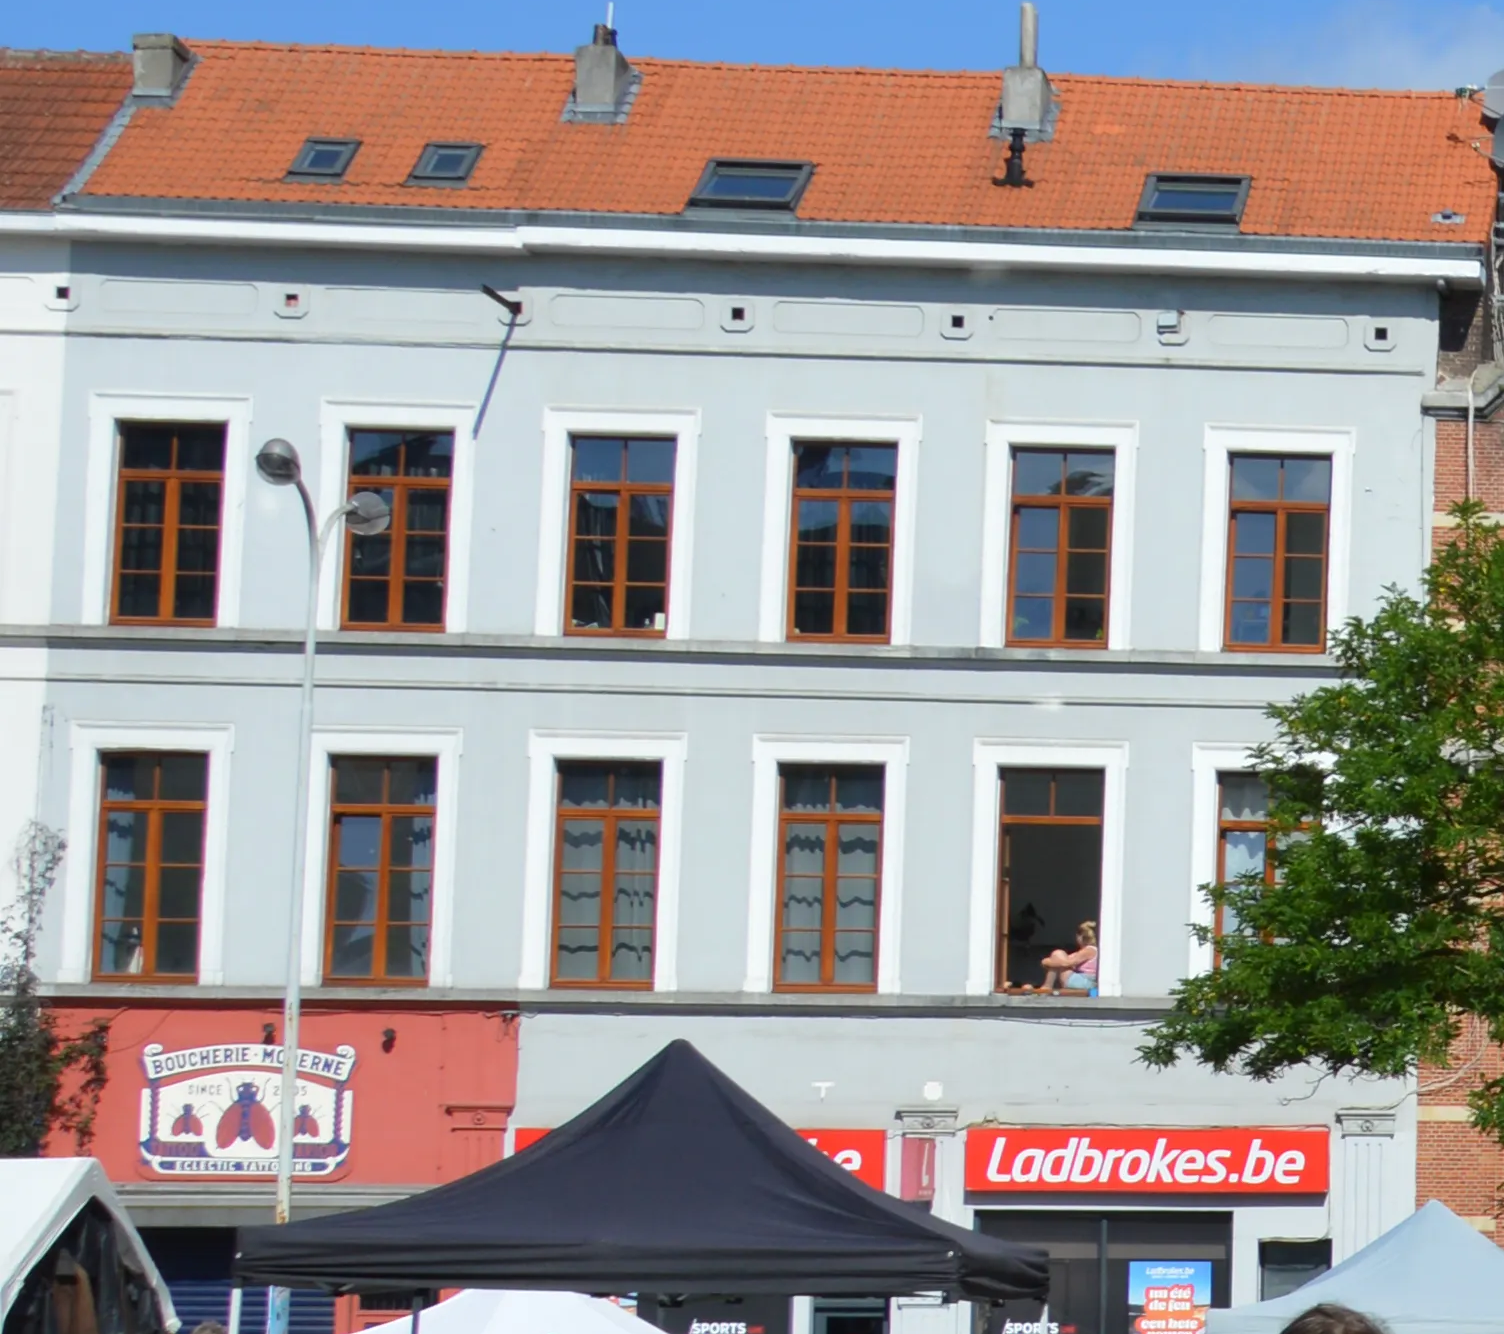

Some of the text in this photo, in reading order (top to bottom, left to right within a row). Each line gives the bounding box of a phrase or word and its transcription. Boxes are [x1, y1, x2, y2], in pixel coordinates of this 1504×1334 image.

[152, 1047, 345, 1076] BOUCHERIE MOERNE
[188, 1085, 223, 1096] SINCE
[987, 1136, 1305, 1184] Ladbrokes.be
[176, 1161, 236, 1172] ECLECTIC
[1149, 1299, 1166, 1311] de
[692, 1322, 746, 1334] SPORTS
[1005, 1322, 1059, 1334] SPORS
